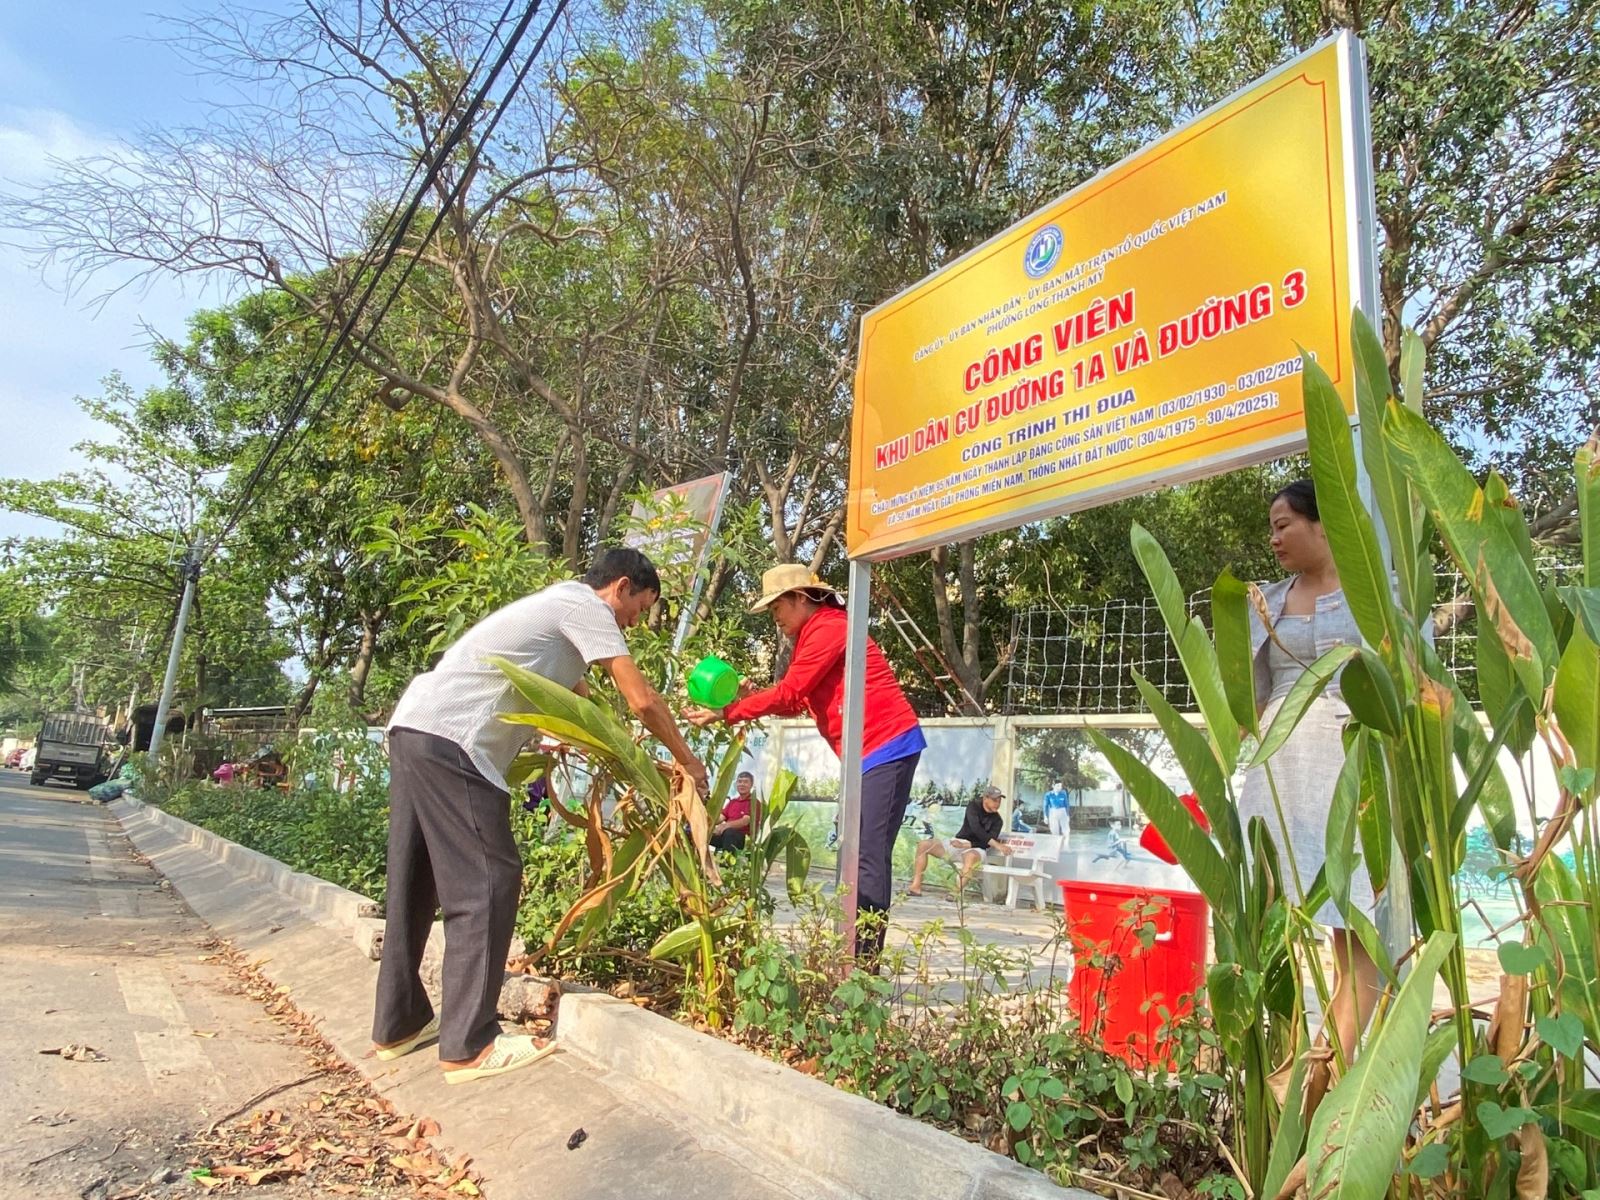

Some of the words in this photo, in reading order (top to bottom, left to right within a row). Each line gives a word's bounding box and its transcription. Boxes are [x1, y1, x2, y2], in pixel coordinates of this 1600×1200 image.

[949, 329, 961, 343] ỦY
[960, 320, 977, 336] BAN
[977, 306, 1001, 326] NHÂN
[1003, 295, 1021, 315] DÂN
[1028, 285, 1041, 300] ỦY
[1042, 275, 1062, 293] BAN
[1064, 262, 1085, 281] MẶT
[1088, 248, 1115, 269] TRẬN
[1117, 234, 1132, 254] TỔ
[1134, 220, 1167, 247] QUỐC
[1169, 208, 1194, 229] VIỆT
[1197, 191, 1227, 215] NAM
[987, 309, 1024, 336] PHƯỜNG
[1025, 299, 1050, 317] LONG
[1088, 267, 1105, 286] MỸ
[876, 434, 910, 468] KHU
[915, 417, 949, 453] DÂN
[955, 398, 982, 436] CƯ
[986, 370, 1064, 423] ĐƯỜNG
[1073, 354, 1106, 389] 1A
[1114, 331, 1150, 373] VÀ
[1158, 284, 1271, 356] ĐƯỜNG
[1284, 271, 1306, 307] 3
[965, 333, 1043, 392] CÔNG
[1054, 290, 1134, 352] VIÊN
[890, 493, 909, 508] MỪNG
[919, 482, 935, 499] NIỆM
[936, 481, 945, 491] 95
[945, 472, 961, 488] NĂM
[962, 465, 982, 481] NGÀY
[984, 455, 1010, 474] THÀNH
[1012, 448, 1027, 466] LẬP
[1029, 441, 1053, 460] ĐẢNG
[1056, 433, 1080, 451] CỘNG
[1083, 423, 1103, 441] SẢN
[1106, 414, 1126, 434] VIỆT
[1130, 407, 1154, 426] NAM
[1158, 383, 1225, 418] (03/02/1930
[1238, 353, 1315, 390] 03/02/202)
[906, 504, 921, 519] NĂM
[922, 498, 939, 513] NGÀY
[955, 485, 980, 501] PHÓNG
[981, 475, 1002, 495] MIỀN
[1004, 472, 1025, 488] NAM,
[1028, 461, 1056, 481] THỐNG
[1058, 451, 1082, 471] NHẤT
[1085, 443, 1103, 463] ĐẤT
[1106, 436, 1134, 456] NƯỚC
[1137, 417, 1195, 447] (30/4/1975
[1207, 393, 1278, 425] 30/4/2025);
[962, 436, 1002, 462] CÔNG
[1007, 416, 1056, 445] TRÌNH
[1063, 404, 1090, 426] THI
[1097, 389, 1136, 414] ĐUA
